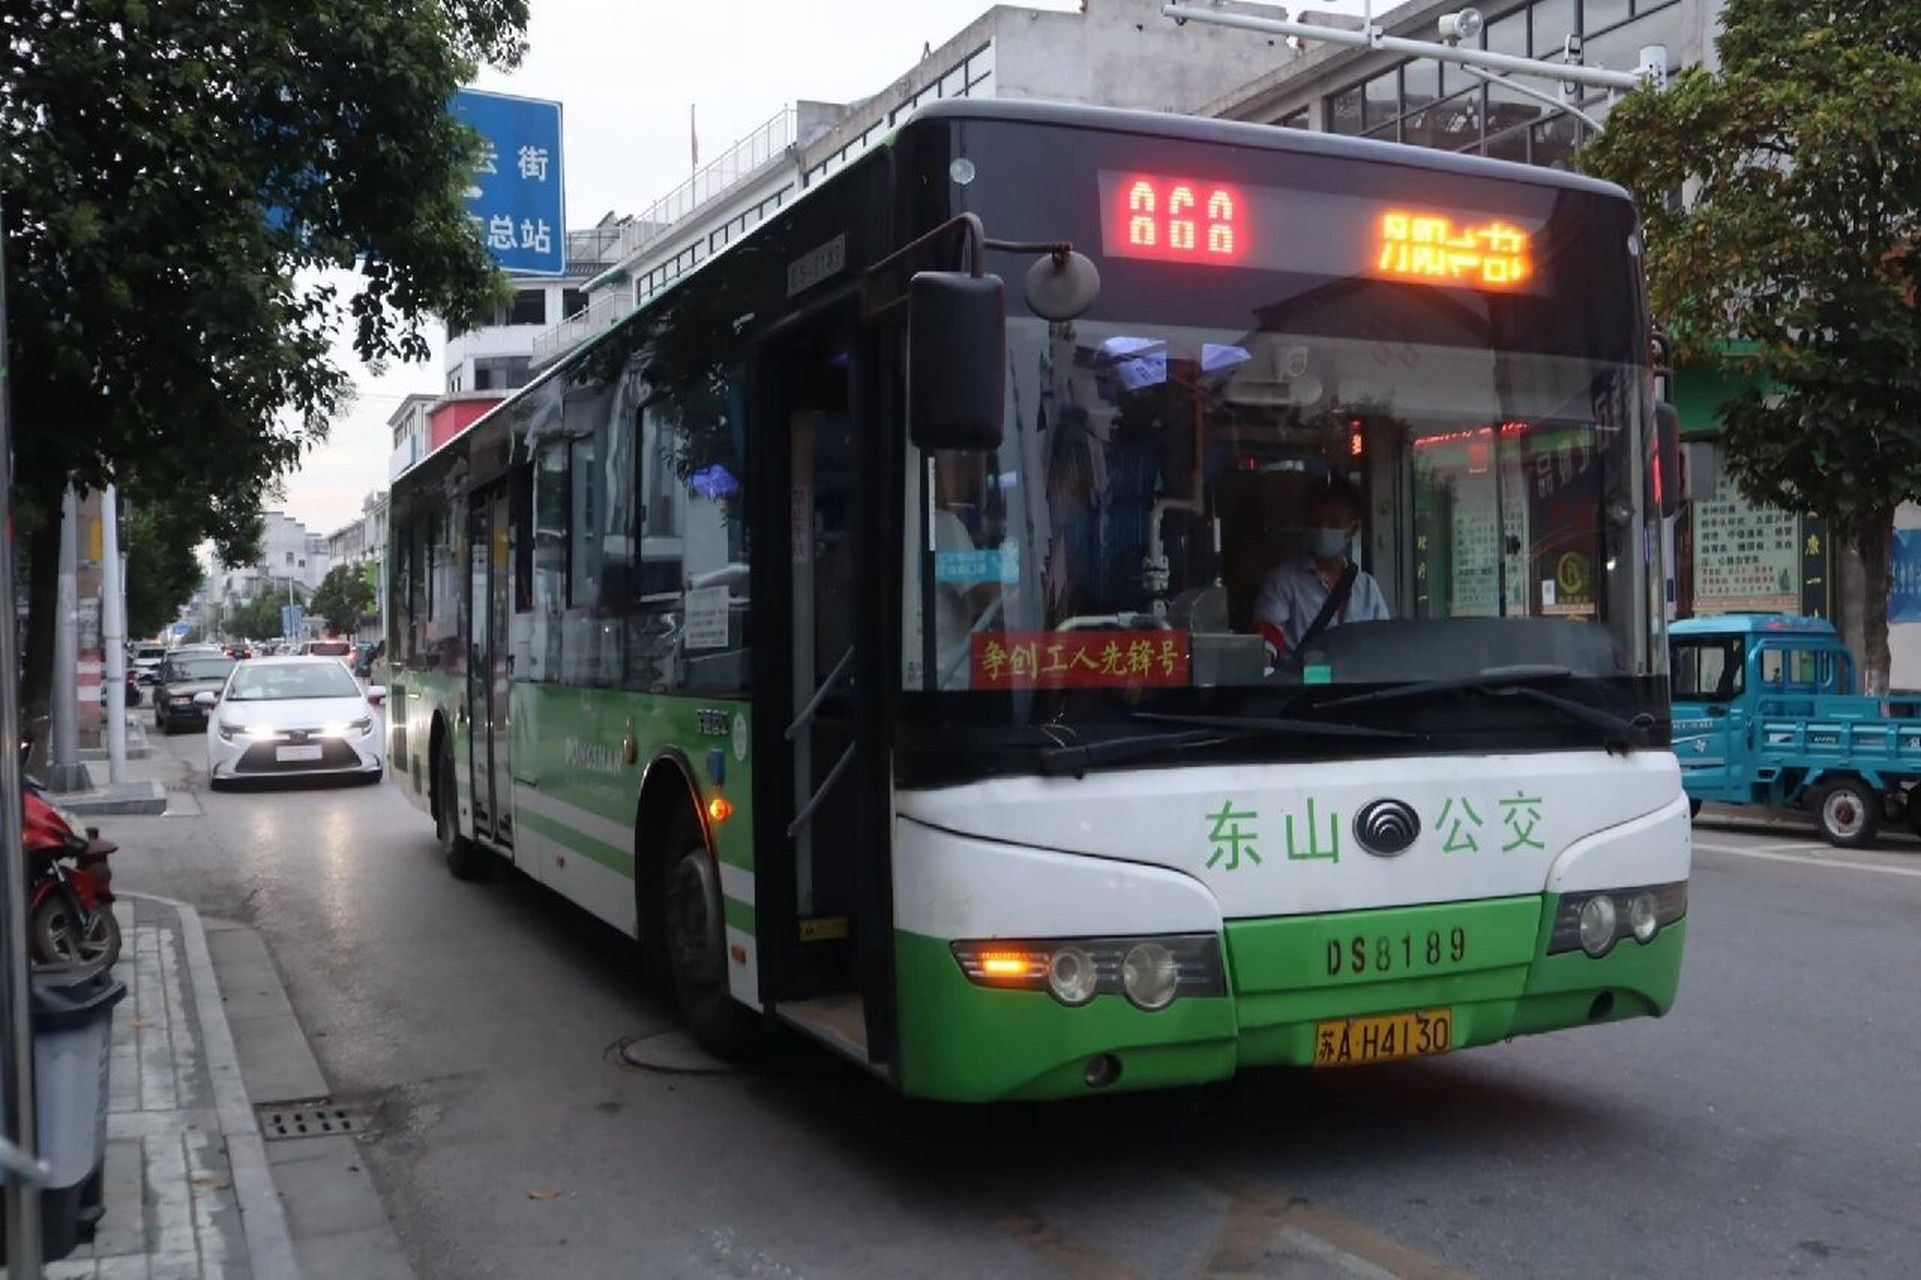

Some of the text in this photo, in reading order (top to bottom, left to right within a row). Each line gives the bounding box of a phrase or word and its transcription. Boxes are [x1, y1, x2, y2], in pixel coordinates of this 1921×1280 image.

[465, 212, 551, 254] 总站
[1129, 181, 1233, 253] 868
[982, 641, 1179, 682] 争创工人先锋号
[1205, 790, 1546, 871] 东山 公交
[1327, 926, 1466, 976] DS8189
